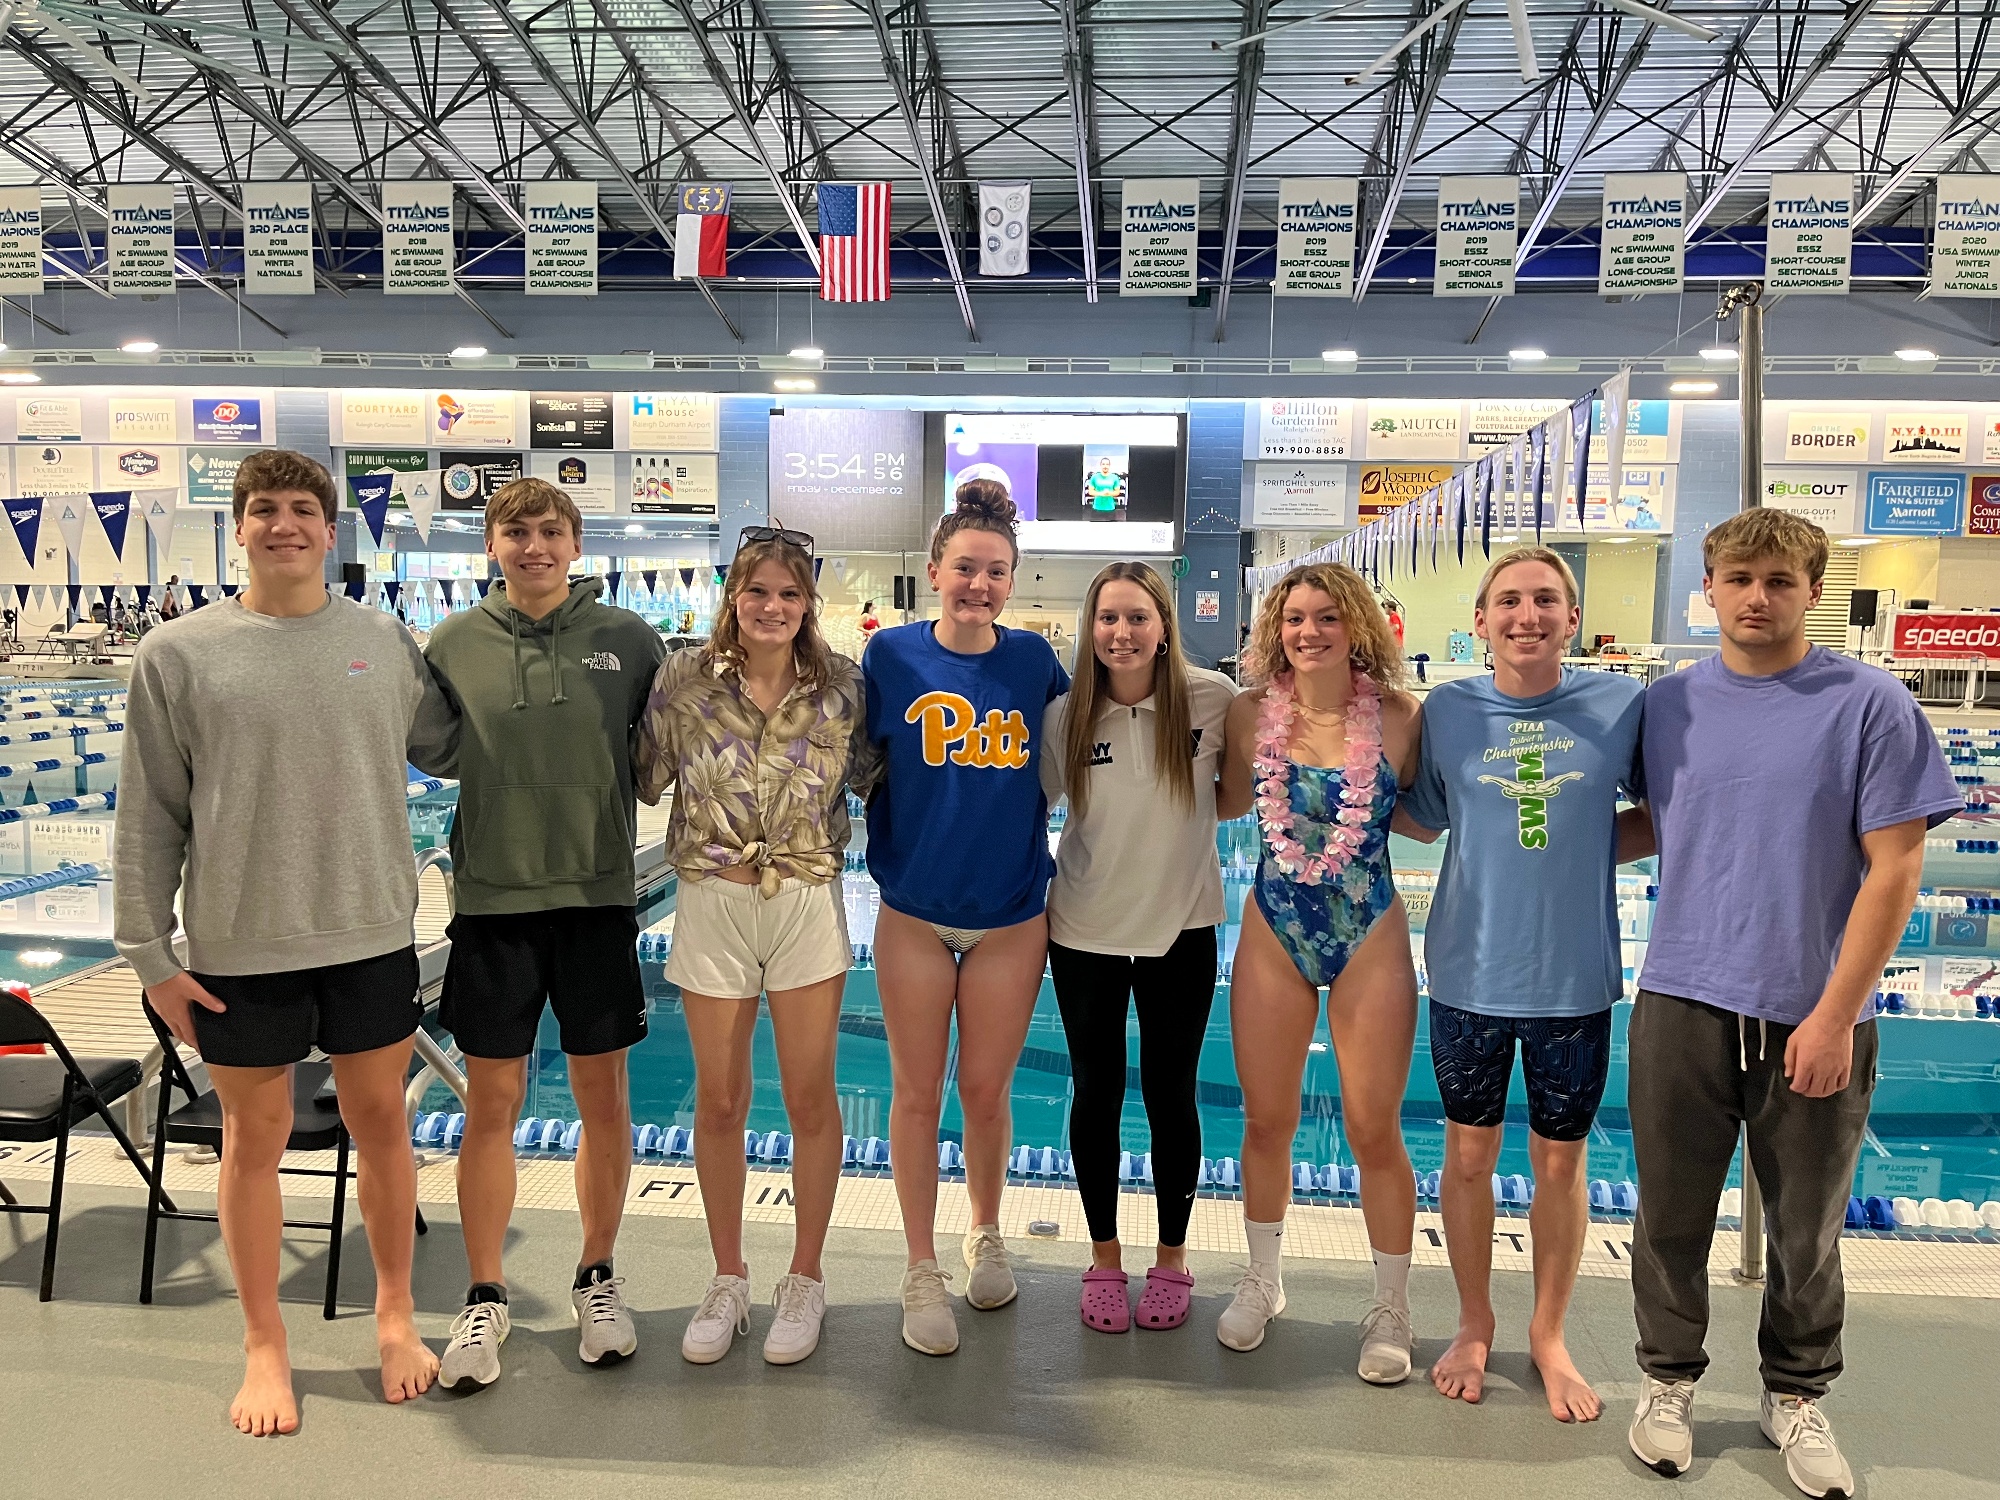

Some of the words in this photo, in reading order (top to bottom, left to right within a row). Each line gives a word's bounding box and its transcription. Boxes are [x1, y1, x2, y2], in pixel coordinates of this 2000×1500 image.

[1125, 199, 1196, 219] TITANS
[1282, 198, 1354, 218] TITANS
[1442, 197, 1516, 217] TITANS
[1606, 194, 1682, 214] TITANS
[1774, 194, 1850, 214] TITANS
[112, 204, 172, 223] TITANS
[248, 202, 310, 220] TITANS
[387, 201, 449, 219] TITANS
[529, 201, 595, 220] TITANS
[1125, 223, 1195, 232] CHAMPIONS
[1281, 222, 1352, 232] CHAMPIONS
[1441, 221, 1514, 231] CHAMPIONS
[1606, 218, 1682, 230] CHAMPIONS
[1772, 218, 1849, 228] CHAMPIONS
[112, 226, 173, 235] CHAMPIONS
[250, 225, 270, 234] 3RD
[274, 225, 308, 233] PLACE
[386, 224, 450, 233] CHAMPIONS
[529, 224, 594, 233] CHAMPIONS
[1611, 246, 1623, 254] NC
[1626, 245, 1675, 253] SWIMMING
[1938, 248, 1958, 256] USA
[1440, 259, 1512, 267] SHORT-COURSE
[1614, 257, 1634, 265] AGE
[1637, 256, 1671, 264] GROUP
[113, 270, 173, 278] SHORT-COURSE
[1310, 271, 1341, 279] GROUP
[1458, 270, 1492, 278] SENIOR
[1608, 267, 1676, 276] LONG-COURSE
[1778, 268, 1837, 276] SECTIONALS
[1956, 271, 1989, 279] JUNIOR
[1125, 281, 1192, 289] CHAMPIONSHIP
[1286, 282, 1342, 290] SECTIONALS
[1446, 281, 1503, 289] SECTIONALS
[1605, 279, 1678, 288] CHAMPIONSHIP
[218, 408, 235, 418] DQ
[347, 405, 418, 413] COURTYARD
[658, 407, 695, 416] house
[633, 421, 658, 429] Raleigh
[1272, 416, 1314, 426] Garden
[1317, 417, 1337, 426] Inn
[1401, 418, 1456, 430] MUTCH
[1792, 435, 1856, 448] BORDER
[1266, 447, 1344, 455] 919-900-8858
[121, 457, 156, 467] Hampton
[349, 455, 364, 465] SHOP
[365, 456, 385, 465] ONLINE
[785, 452, 867, 479] 3:54
[874, 453, 904, 466] PM
[874, 467, 903, 481] 56
[1382, 467, 1426, 483] JOSEPH
[1629, 472, 1648, 481] CEI
[359, 486, 386, 496] speedo
[1775, 484, 1849, 495] BUGOUT
[1879, 482, 1954, 497] FAIRFIELD
[98, 503, 125, 513] speedo
[1889, 507, 1936, 518] Marriott
[11, 508, 38, 519] speedo
[1904, 625, 1996, 649] speedo
[905, 691, 1030, 770] Pitt
[1514, 722, 1545, 733] PIAA
[1483, 737, 1575, 763] Championship
[638, 1181, 695, 1199] FT
[756, 1187, 795, 1206] IN
